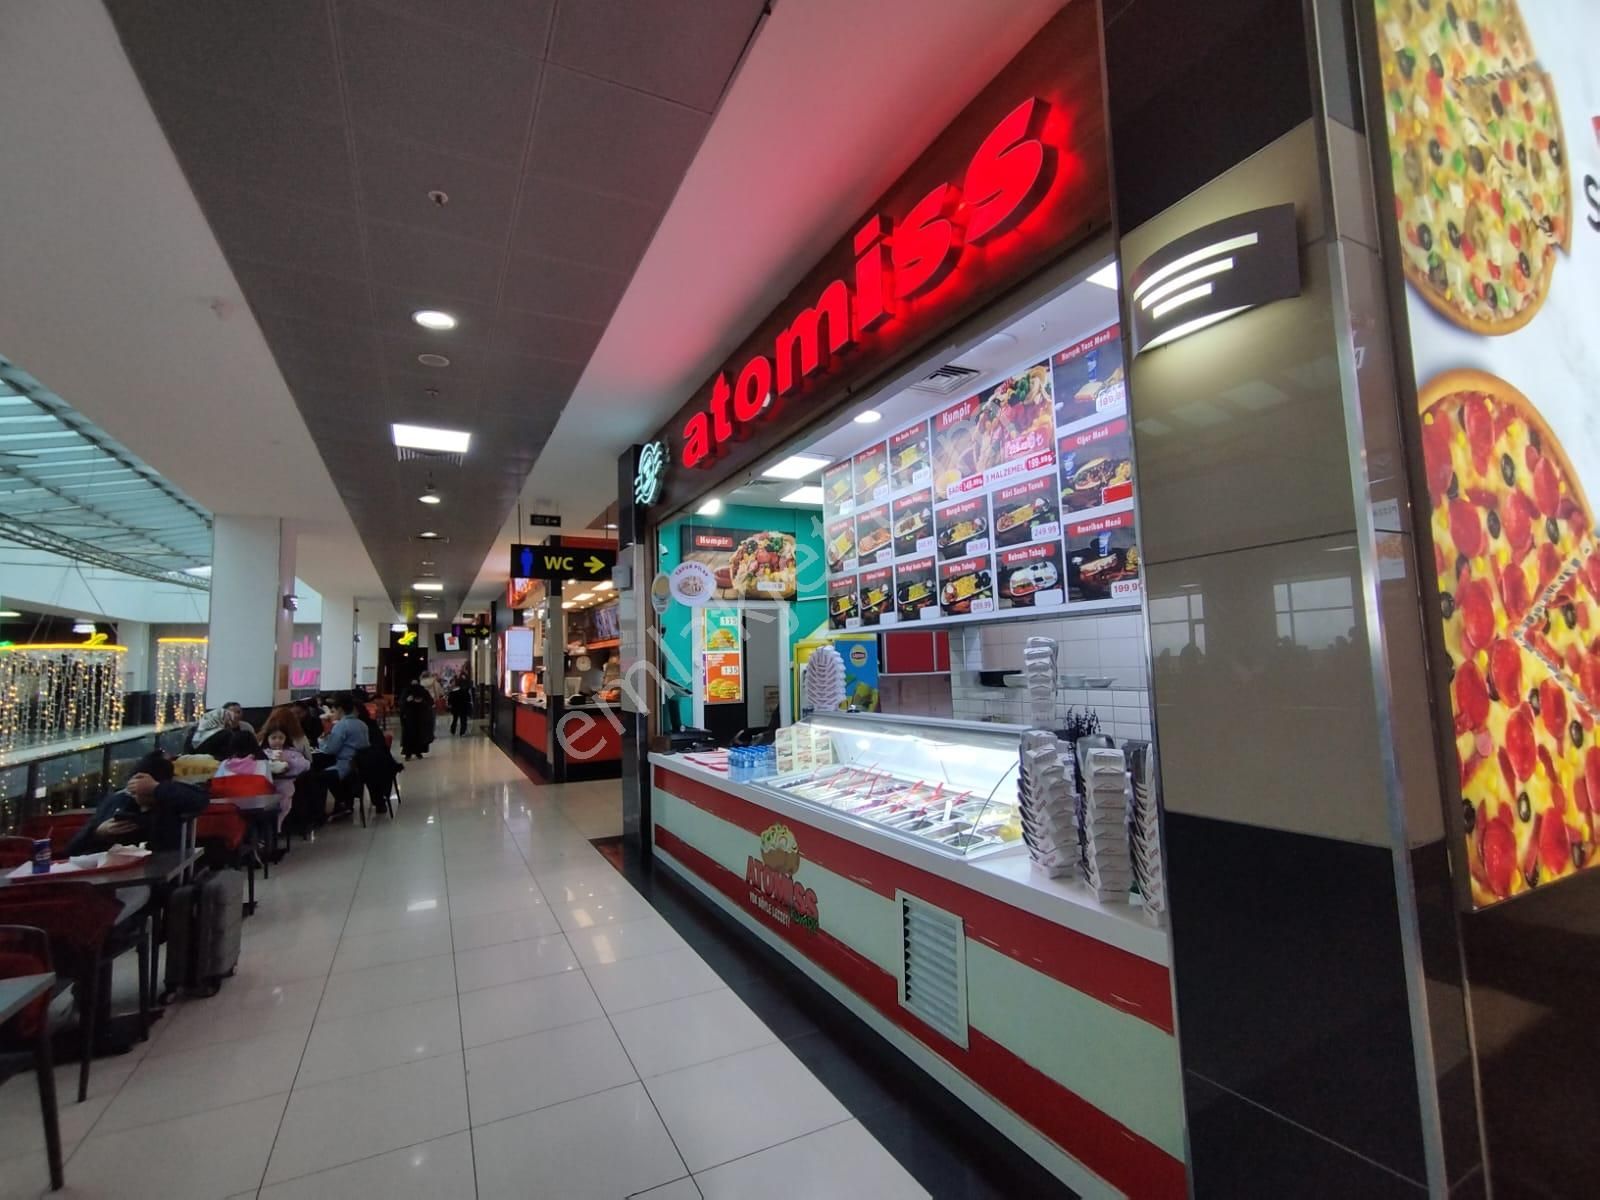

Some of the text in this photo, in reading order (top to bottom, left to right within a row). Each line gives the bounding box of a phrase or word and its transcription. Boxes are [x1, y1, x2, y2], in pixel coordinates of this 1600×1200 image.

[682, 96, 1050, 469] atomiss
[942, 402, 971, 425] Kumpir
[699, 535, 729, 547] Kumpir
[543, 555, 574, 571] WC
